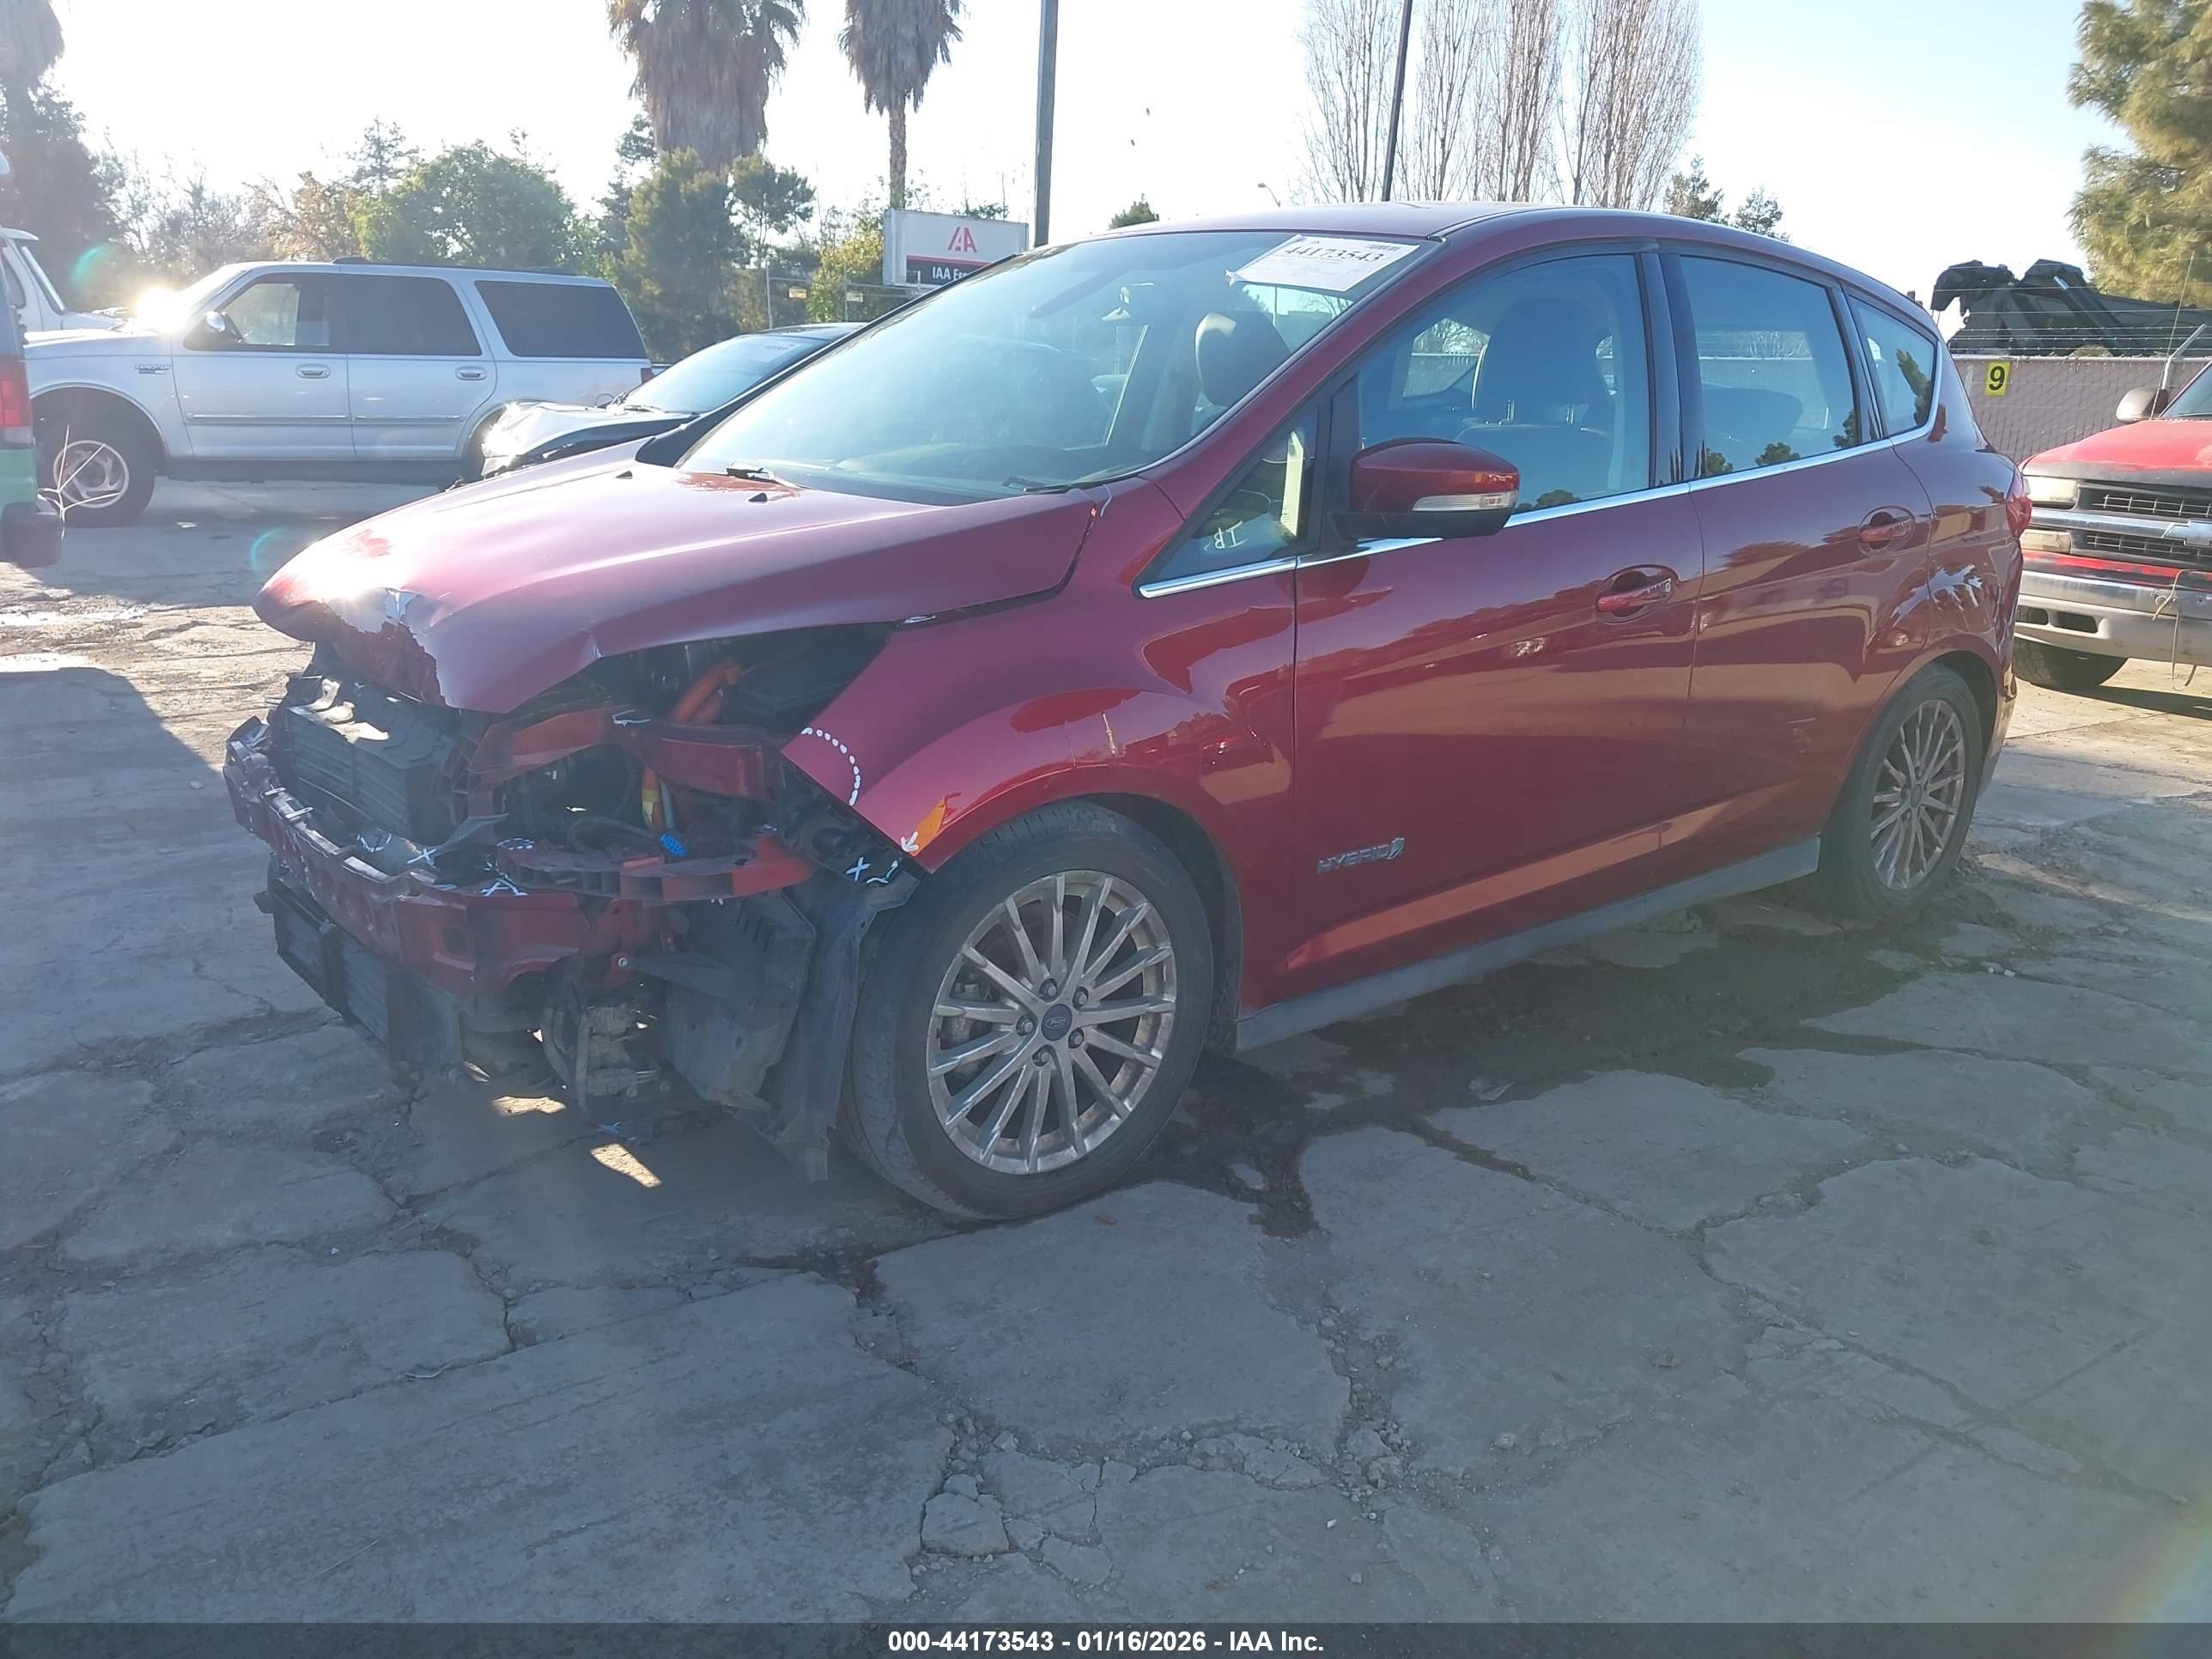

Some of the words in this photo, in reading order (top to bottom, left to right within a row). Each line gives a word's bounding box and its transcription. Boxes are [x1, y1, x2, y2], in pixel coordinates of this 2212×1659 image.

[1285, 246, 1383, 261] 44173543
[933, 266, 951, 280] IAA
[1989, 366, 2005, 391] 9
